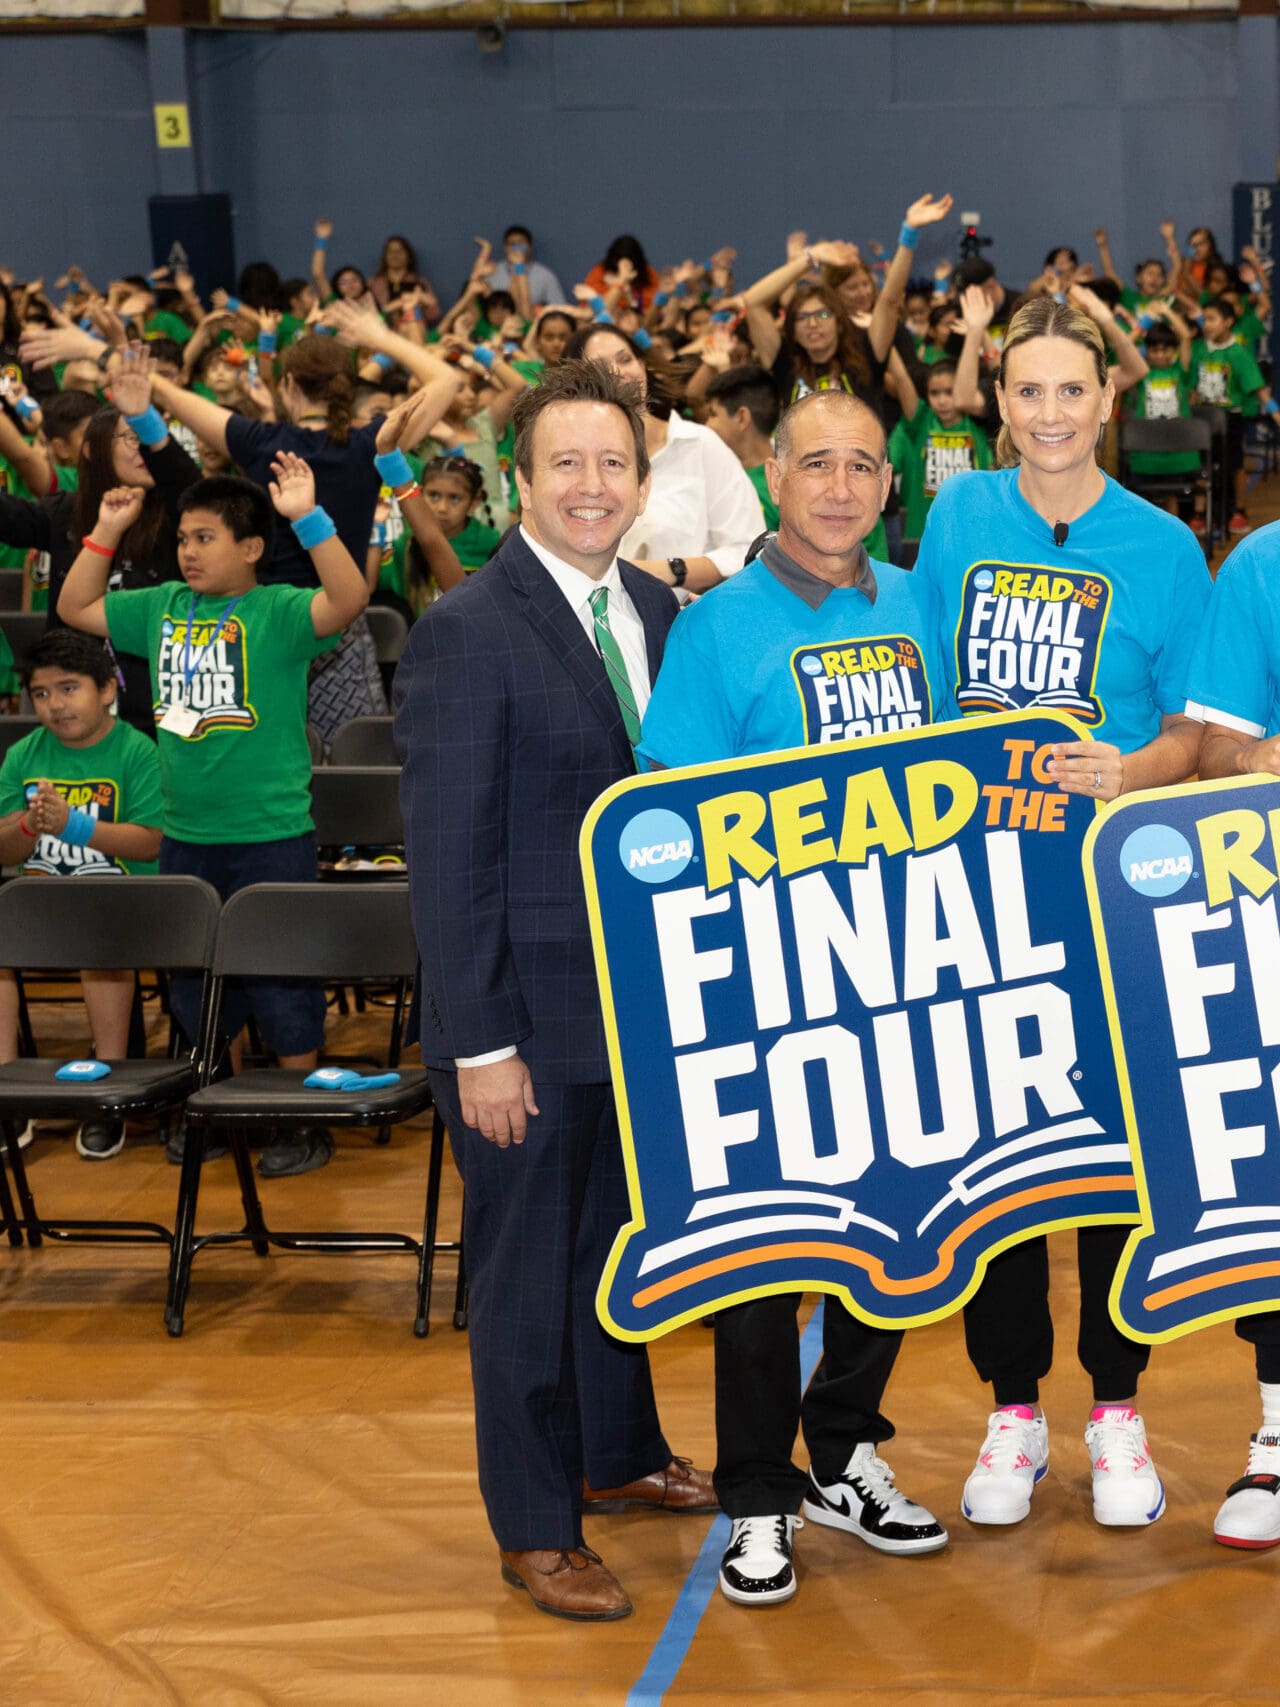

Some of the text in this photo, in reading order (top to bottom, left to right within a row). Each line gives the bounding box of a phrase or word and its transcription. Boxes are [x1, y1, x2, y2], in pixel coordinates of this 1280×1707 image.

[165, 115, 181, 139] 3
[993, 570, 1075, 602] READ
[1072, 589, 1100, 610] THE
[1083, 578, 1103, 596] TO
[969, 592, 1085, 649] FINAL
[821, 645, 896, 679] READ
[896, 653, 918, 669] THE
[897, 641, 914, 655] TO
[968, 638, 1083, 692] FOUR
[157, 671, 236, 709] FOUR
[812, 665, 922, 724] FINAL
[697, 760, 979, 891] READ
[981, 785, 1069, 832] THE
[628, 839, 692, 869] NCAA
[1130, 855, 1192, 882] NCAA
[652, 830, 1066, 1047] FINAL
[675, 982, 1085, 1192] FOUR
